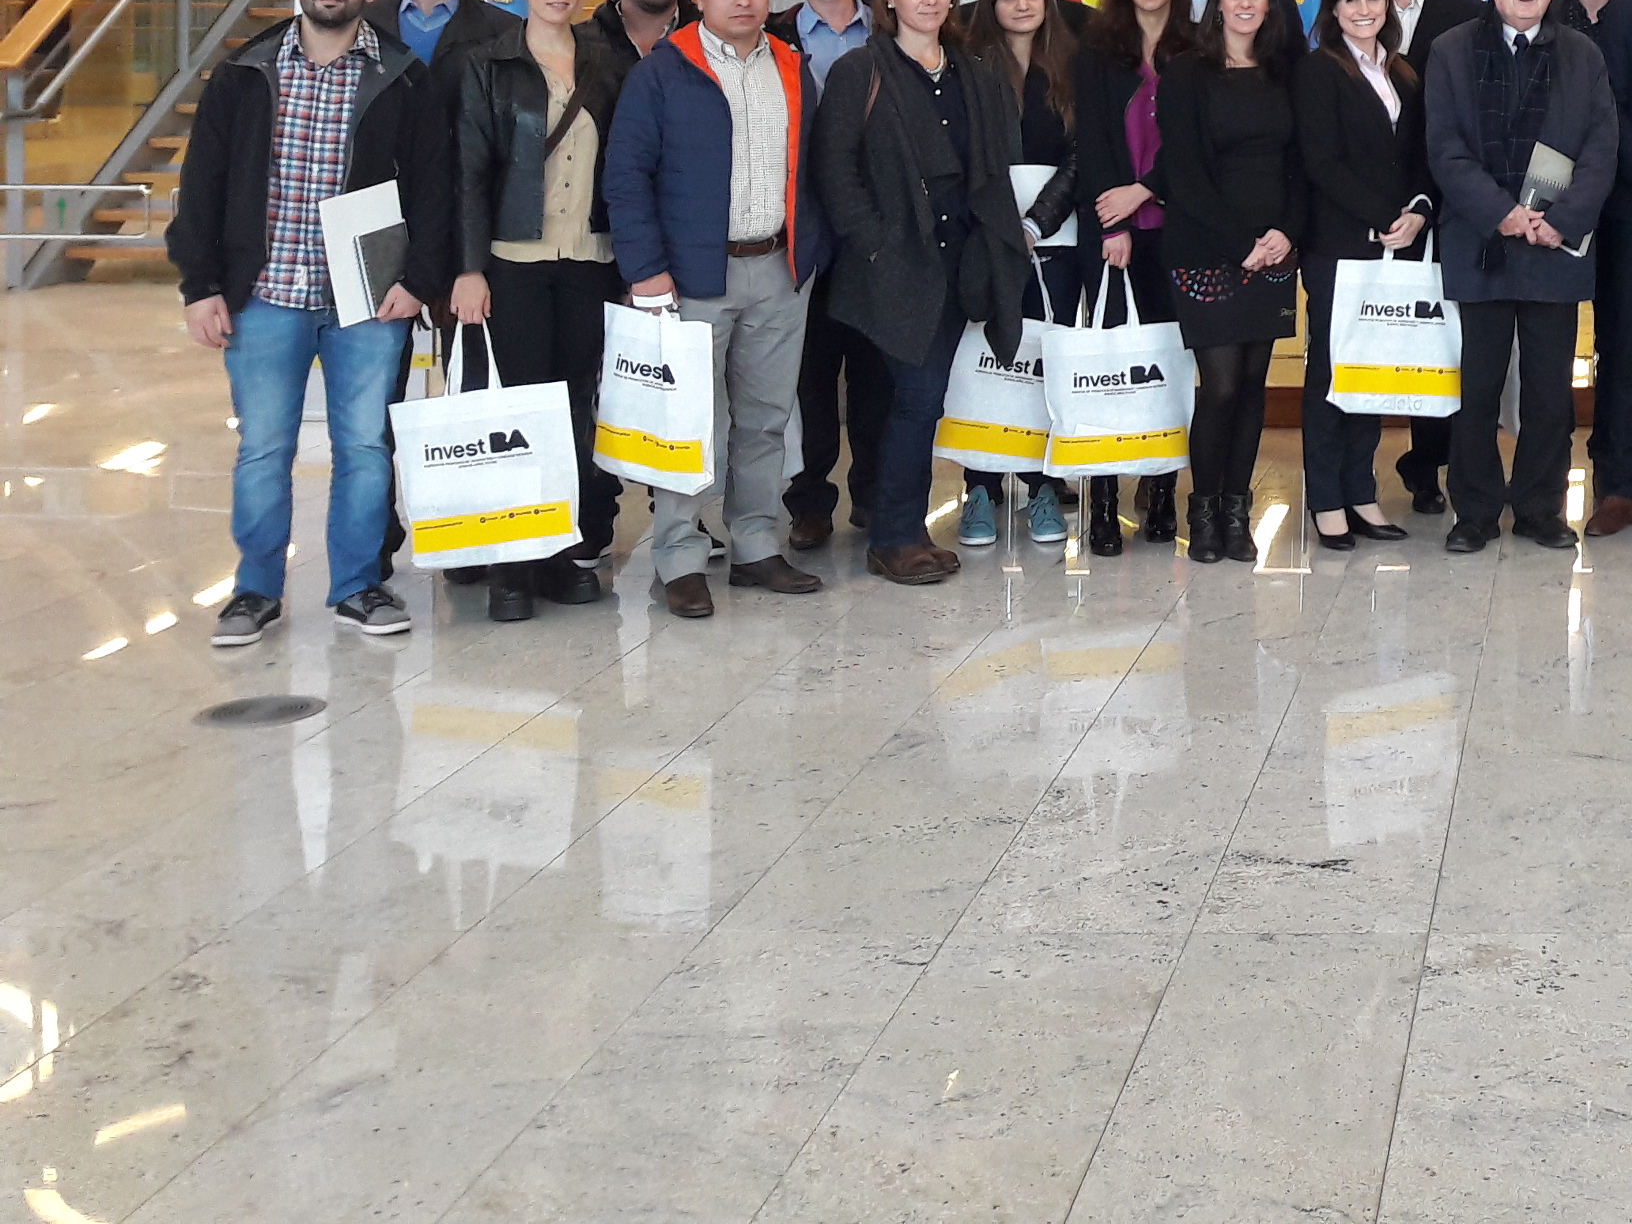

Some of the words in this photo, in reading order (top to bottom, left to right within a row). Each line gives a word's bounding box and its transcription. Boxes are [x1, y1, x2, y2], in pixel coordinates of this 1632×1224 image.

[1360, 300, 1412, 318] invest
[1414, 300, 1445, 320] BA
[615, 353, 663, 380] inves
[1073, 371, 1127, 388] invest
[1129, 363, 1165, 385] BA
[424, 439, 487, 462] invest
[489, 429, 530, 454] BA
